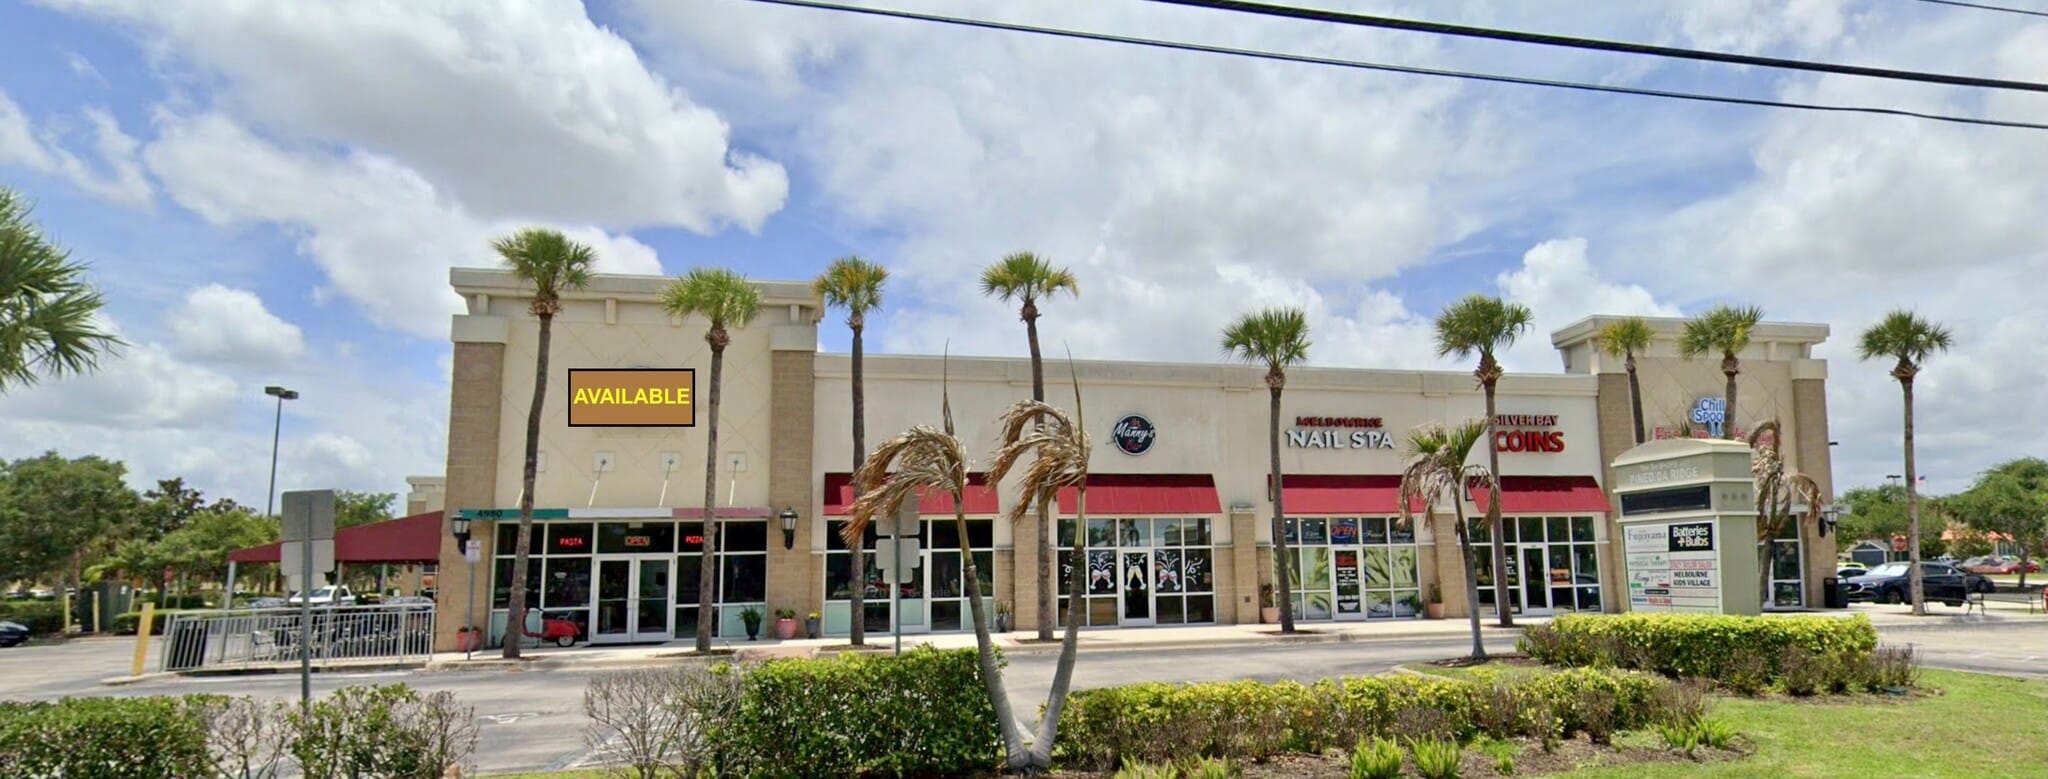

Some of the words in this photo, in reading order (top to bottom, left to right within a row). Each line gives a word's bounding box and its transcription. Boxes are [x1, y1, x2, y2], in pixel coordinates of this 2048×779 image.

[1495, 415, 1532, 426] SILVER
[1534, 415, 1559, 426] BAY
[1112, 422, 1154, 443] Manny's
[1286, 430, 1345, 449] NAIL
[1350, 431, 1396, 449] SPA
[1496, 431, 1565, 452] COINS
[1331, 526, 1357, 536] OPEN
[1672, 526, 1709, 538] Batteries
[560, 538, 583, 546] PASTA
[627, 537, 648, 545] OPEN
[1673, 571, 1708, 579] MELBOURNE
[1673, 579, 1687, 587] KIDS
[1687, 579, 1711, 587] VILLAGE
